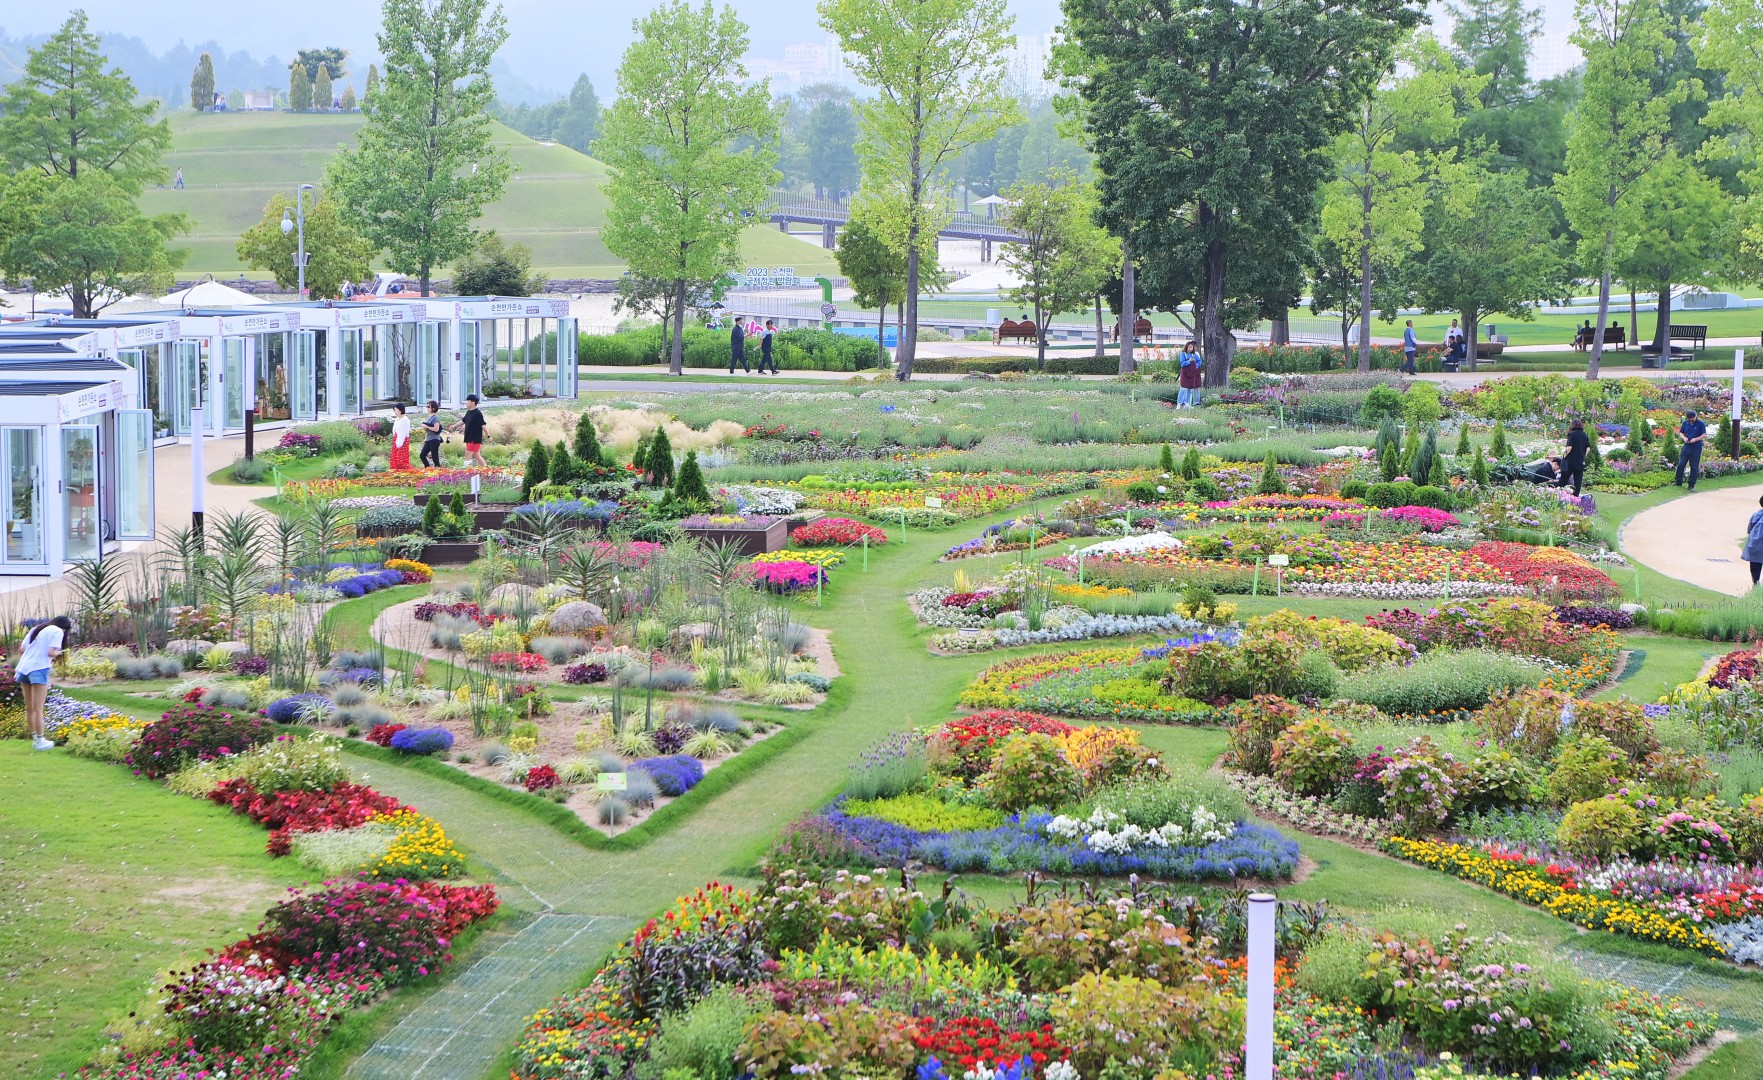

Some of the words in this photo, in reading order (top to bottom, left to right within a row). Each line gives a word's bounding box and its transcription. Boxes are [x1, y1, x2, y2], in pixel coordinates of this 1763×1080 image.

[746, 267, 768, 277] 2023
[772, 267, 794, 277] 순천만
[491, 303, 523, 312] 순천만가든쇼
